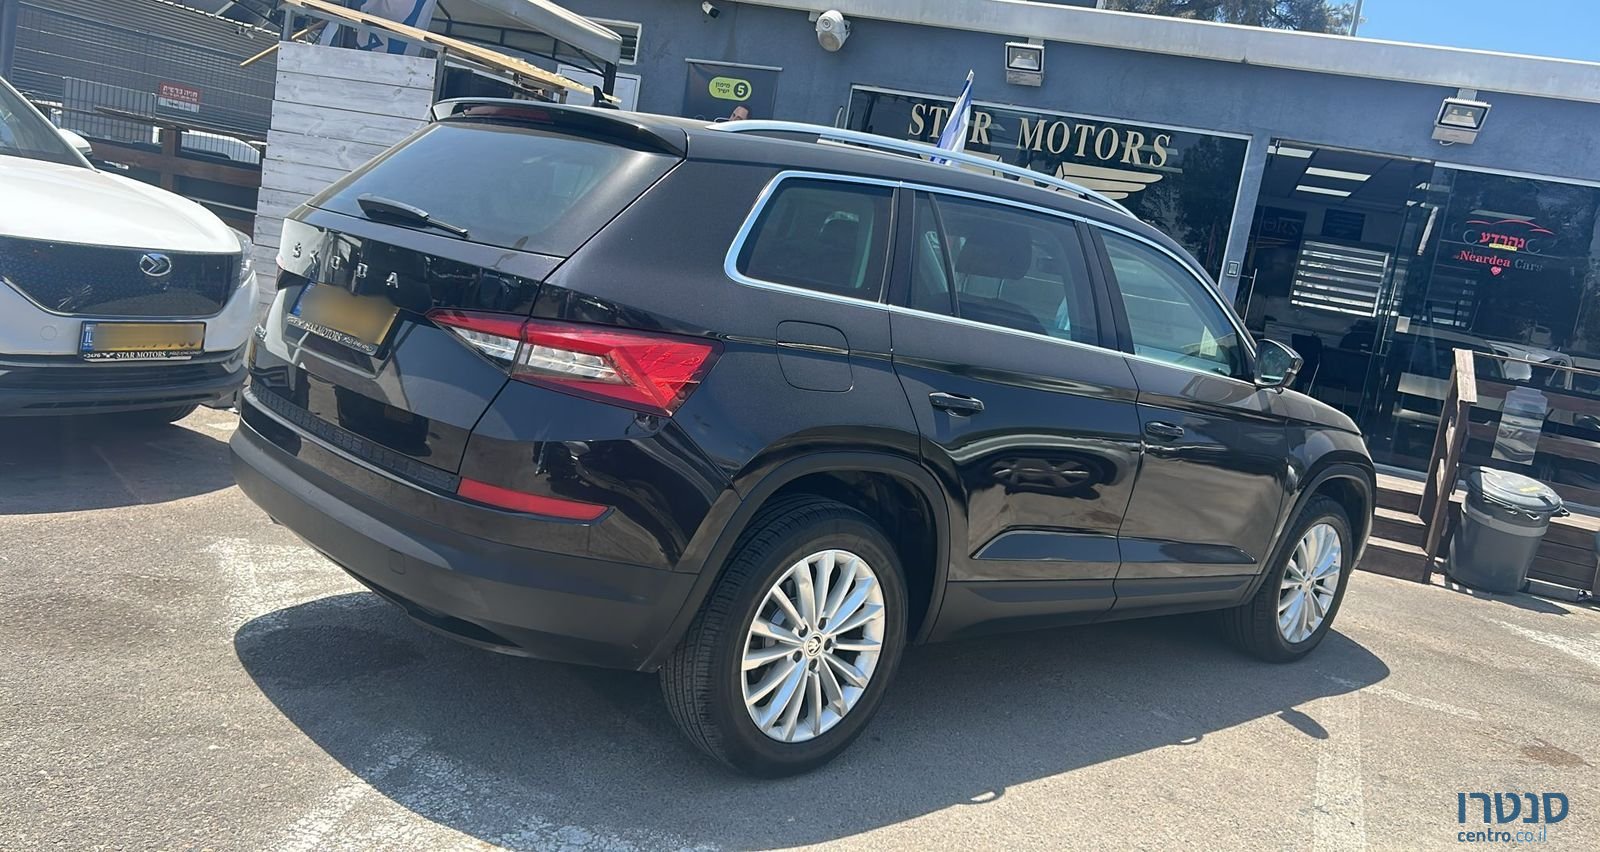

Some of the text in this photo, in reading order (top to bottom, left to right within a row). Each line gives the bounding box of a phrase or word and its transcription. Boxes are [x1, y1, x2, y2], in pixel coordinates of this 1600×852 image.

[736, 85, 746, 96] 5
[908, 103, 1171, 168] STR MOTORS
[1460, 250, 1511, 268] Neardea
[116, 351, 135, 359] STAR
[137, 350, 167, 358] MOTORS
